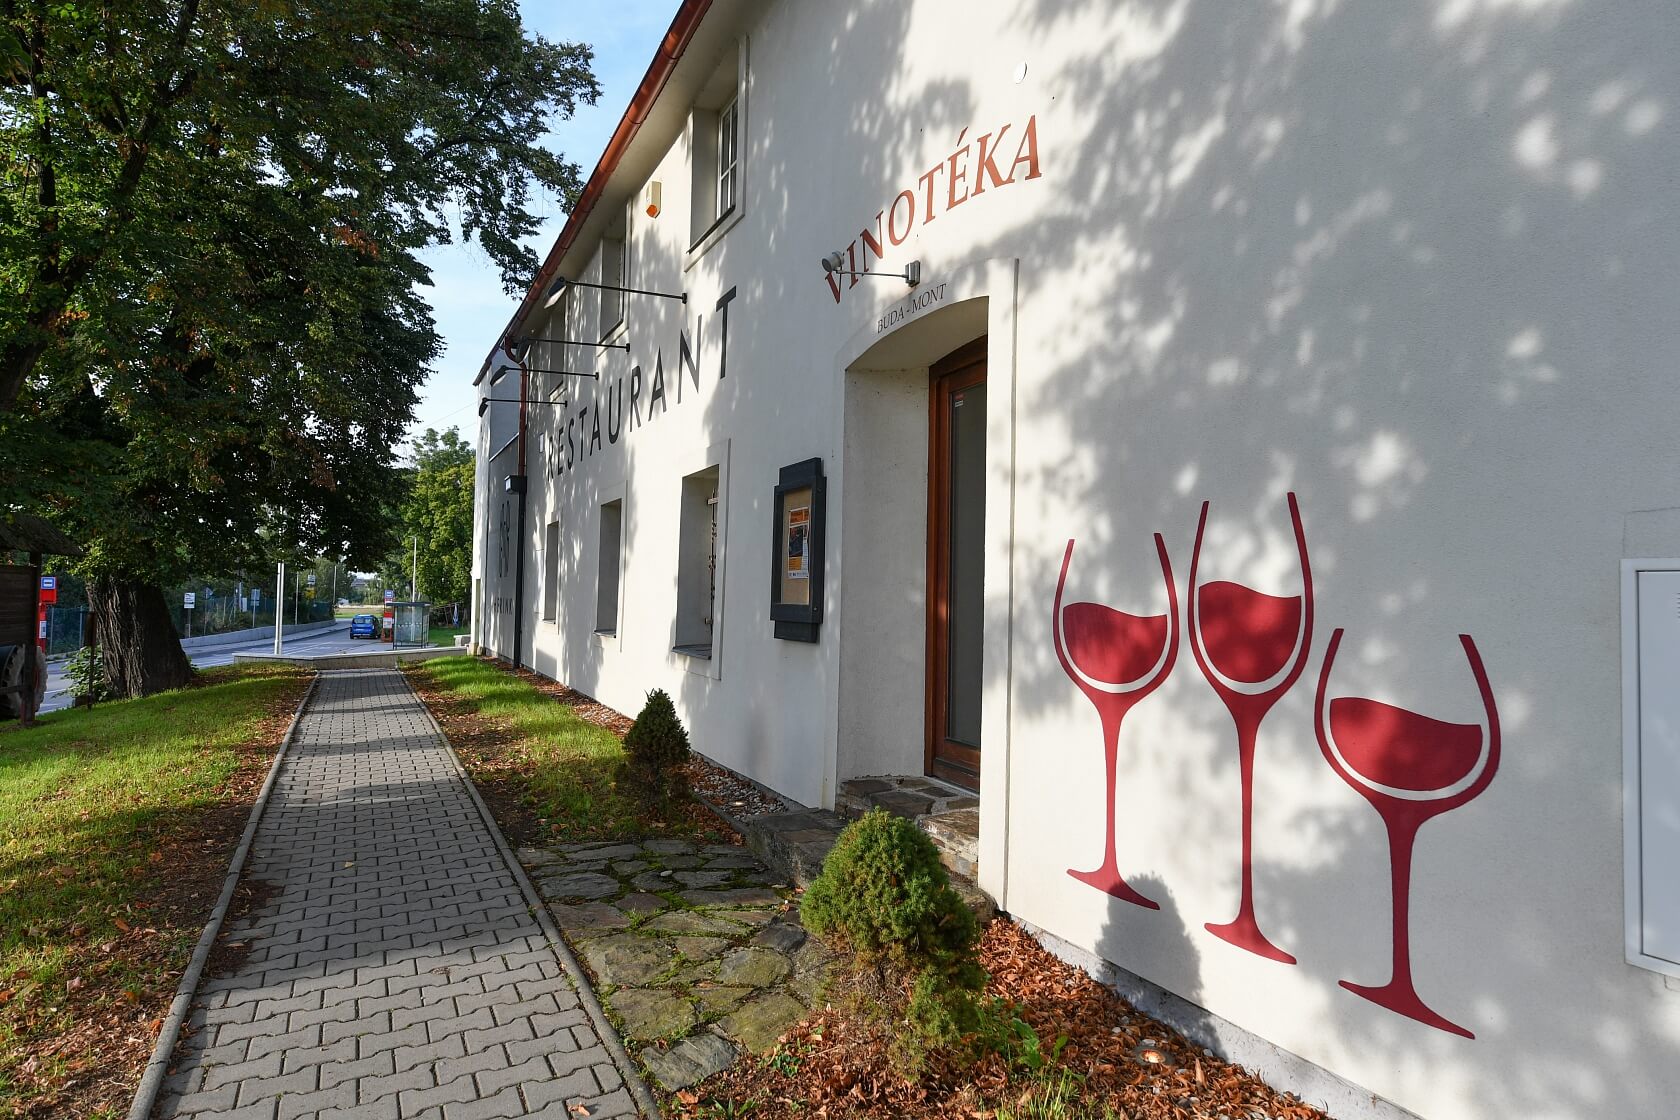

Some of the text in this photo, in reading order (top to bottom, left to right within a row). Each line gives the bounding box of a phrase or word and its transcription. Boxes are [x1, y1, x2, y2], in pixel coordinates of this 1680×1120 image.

[825, 115, 1042, 304] VINOTÉKA
[548, 286, 737, 482] RESTAURANT
[877, 305, 904, 334] BUDA
[912, 283, 947, 314] MONT
